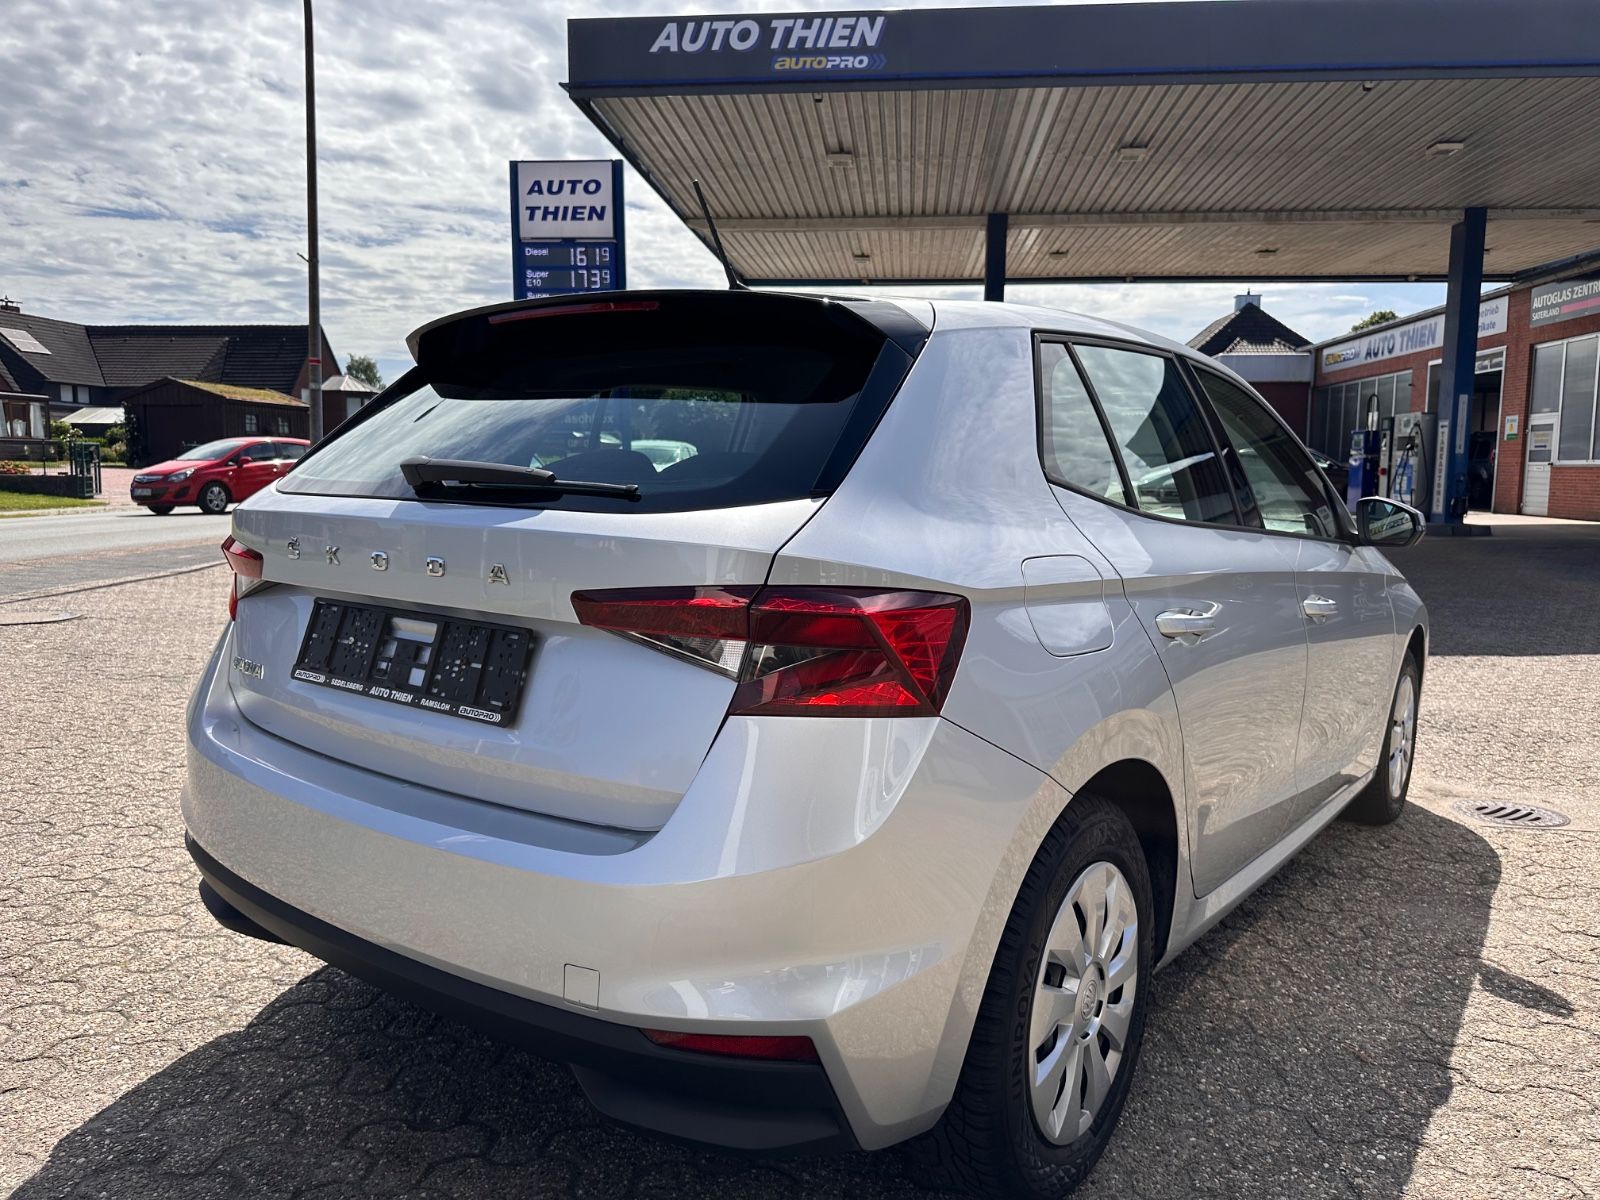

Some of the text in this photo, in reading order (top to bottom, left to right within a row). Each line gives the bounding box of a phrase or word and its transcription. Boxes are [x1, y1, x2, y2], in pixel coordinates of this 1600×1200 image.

[649, 16, 885, 53] AUTO THIEN
[526, 179, 602, 196] AUTO
[525, 205, 607, 222] THIEN
[525, 247, 549, 256] Diesel
[526, 270, 549, 279] Super
[526, 278, 542, 287] E10
[1532, 280, 1600, 309] AUTOGLAS ZENTR
[1479, 304, 1499, 319] etrieb
[1364, 335, 1395, 361] AUTO
[1399, 322, 1438, 352] THIEN
[286, 536, 511, 586] ŠKODA
[330, 678, 364, 692] SEDELSBERG
[369, 686, 390, 698] AUTO
[390, 689, 414, 703] THIEN
[420, 698, 451, 711] RAMSLOH
[1008, 943, 1043, 1101] UNIROYAL
